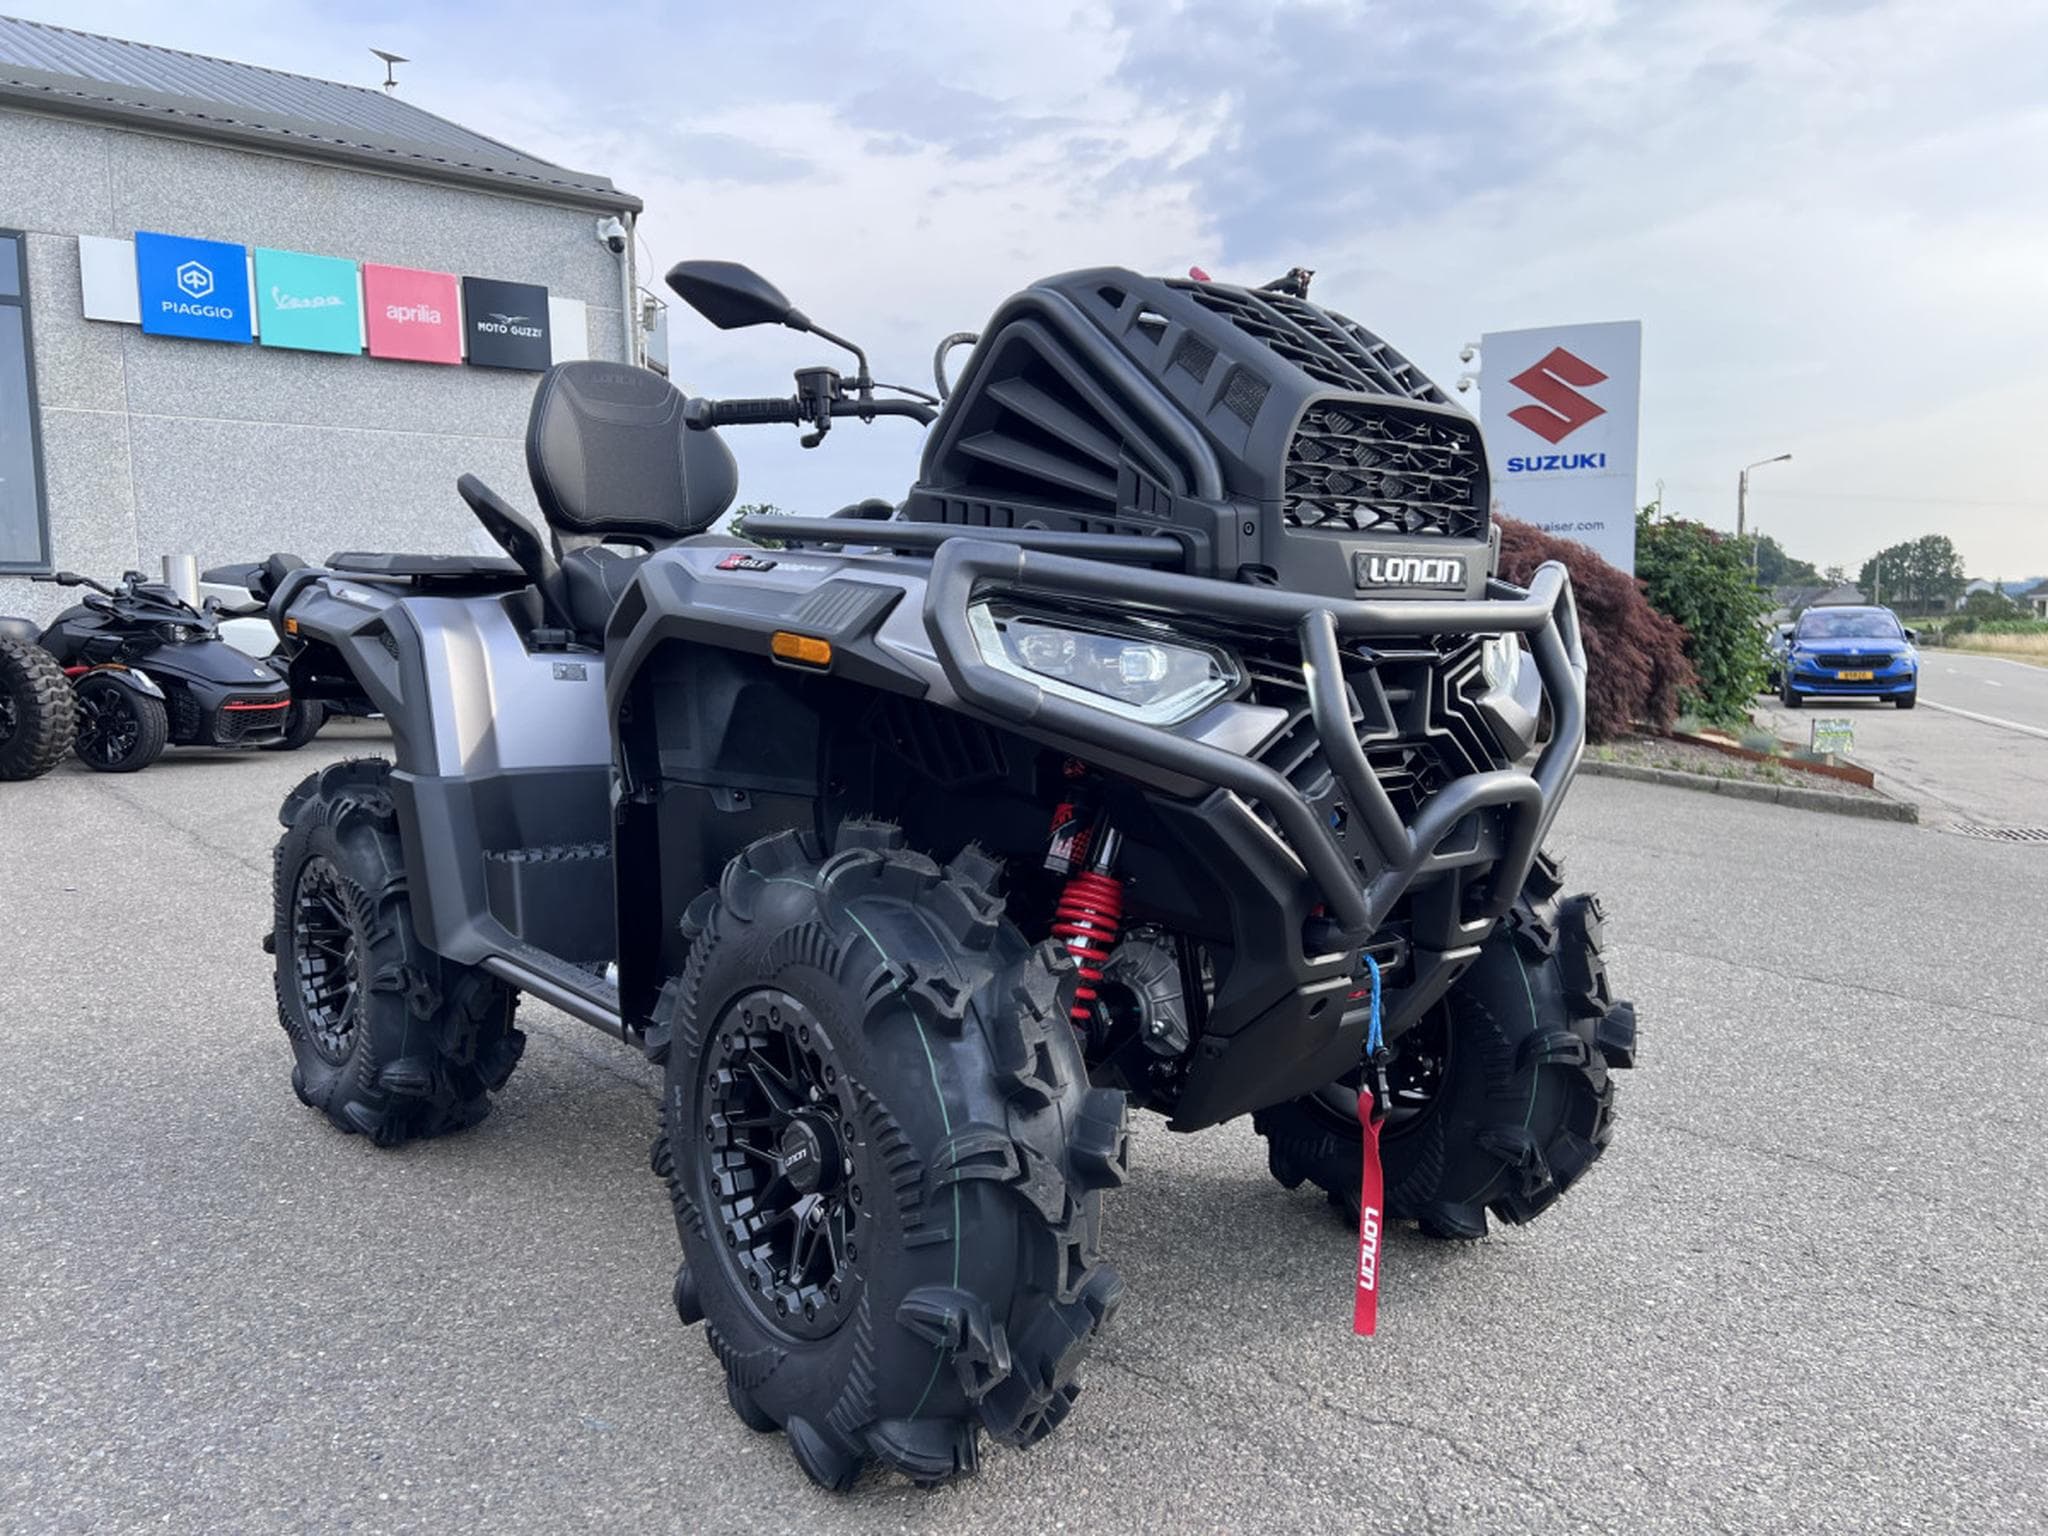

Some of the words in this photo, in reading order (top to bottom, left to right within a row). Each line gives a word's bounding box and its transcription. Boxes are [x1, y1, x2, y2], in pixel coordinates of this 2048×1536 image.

[271, 286, 345, 310] Vespa
[161, 301, 233, 320] PIAGGIO
[386, 304, 442, 324] aprilia
[477, 321, 508, 334] MOTO
[510, 326, 543, 338] GUZZI
[1507, 453, 1606, 472] SUZUKI
[1369, 557, 1461, 583] LONCIN
